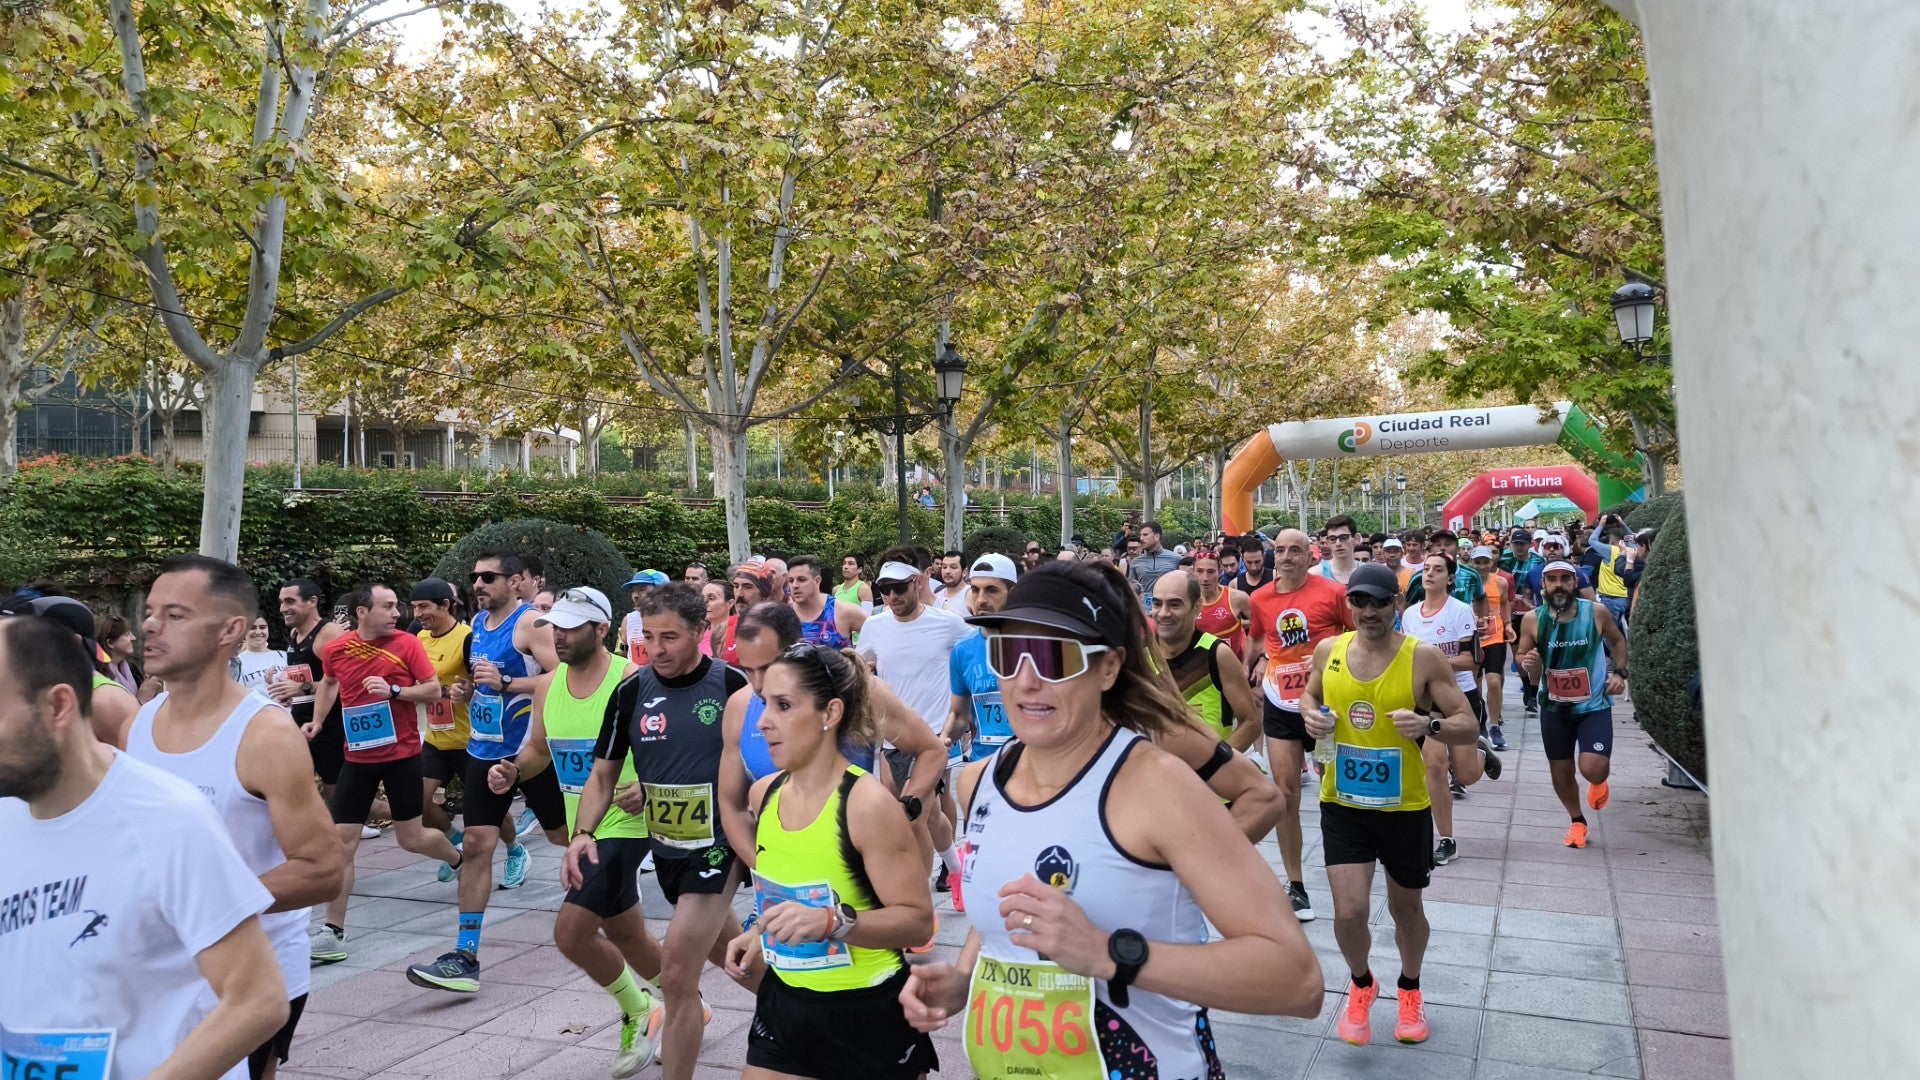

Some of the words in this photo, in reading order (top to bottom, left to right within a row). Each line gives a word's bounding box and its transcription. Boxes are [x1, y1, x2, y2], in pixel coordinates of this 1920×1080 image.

[1378, 416, 1443, 433] Ciudad
[1449, 412, 1491, 428] Real
[1380, 436, 1449, 451] Deporte
[1491, 477, 1508, 489] La
[1511, 474, 1562, 488] Tribuna
[1553, 676, 1581, 690] 120
[350, 713, 383, 733] 663
[471, 702, 493, 724] 646
[982, 704, 1009, 724] 73
[557, 751, 594, 773] 793
[1344, 759, 1390, 784] 829
[658, 788, 680, 798] 10K
[646, 799, 709, 825] 1274
[42, 874, 88, 921] TEAM
[981, 961, 998, 982] IX
[971, 990, 1089, 1057] 1056
